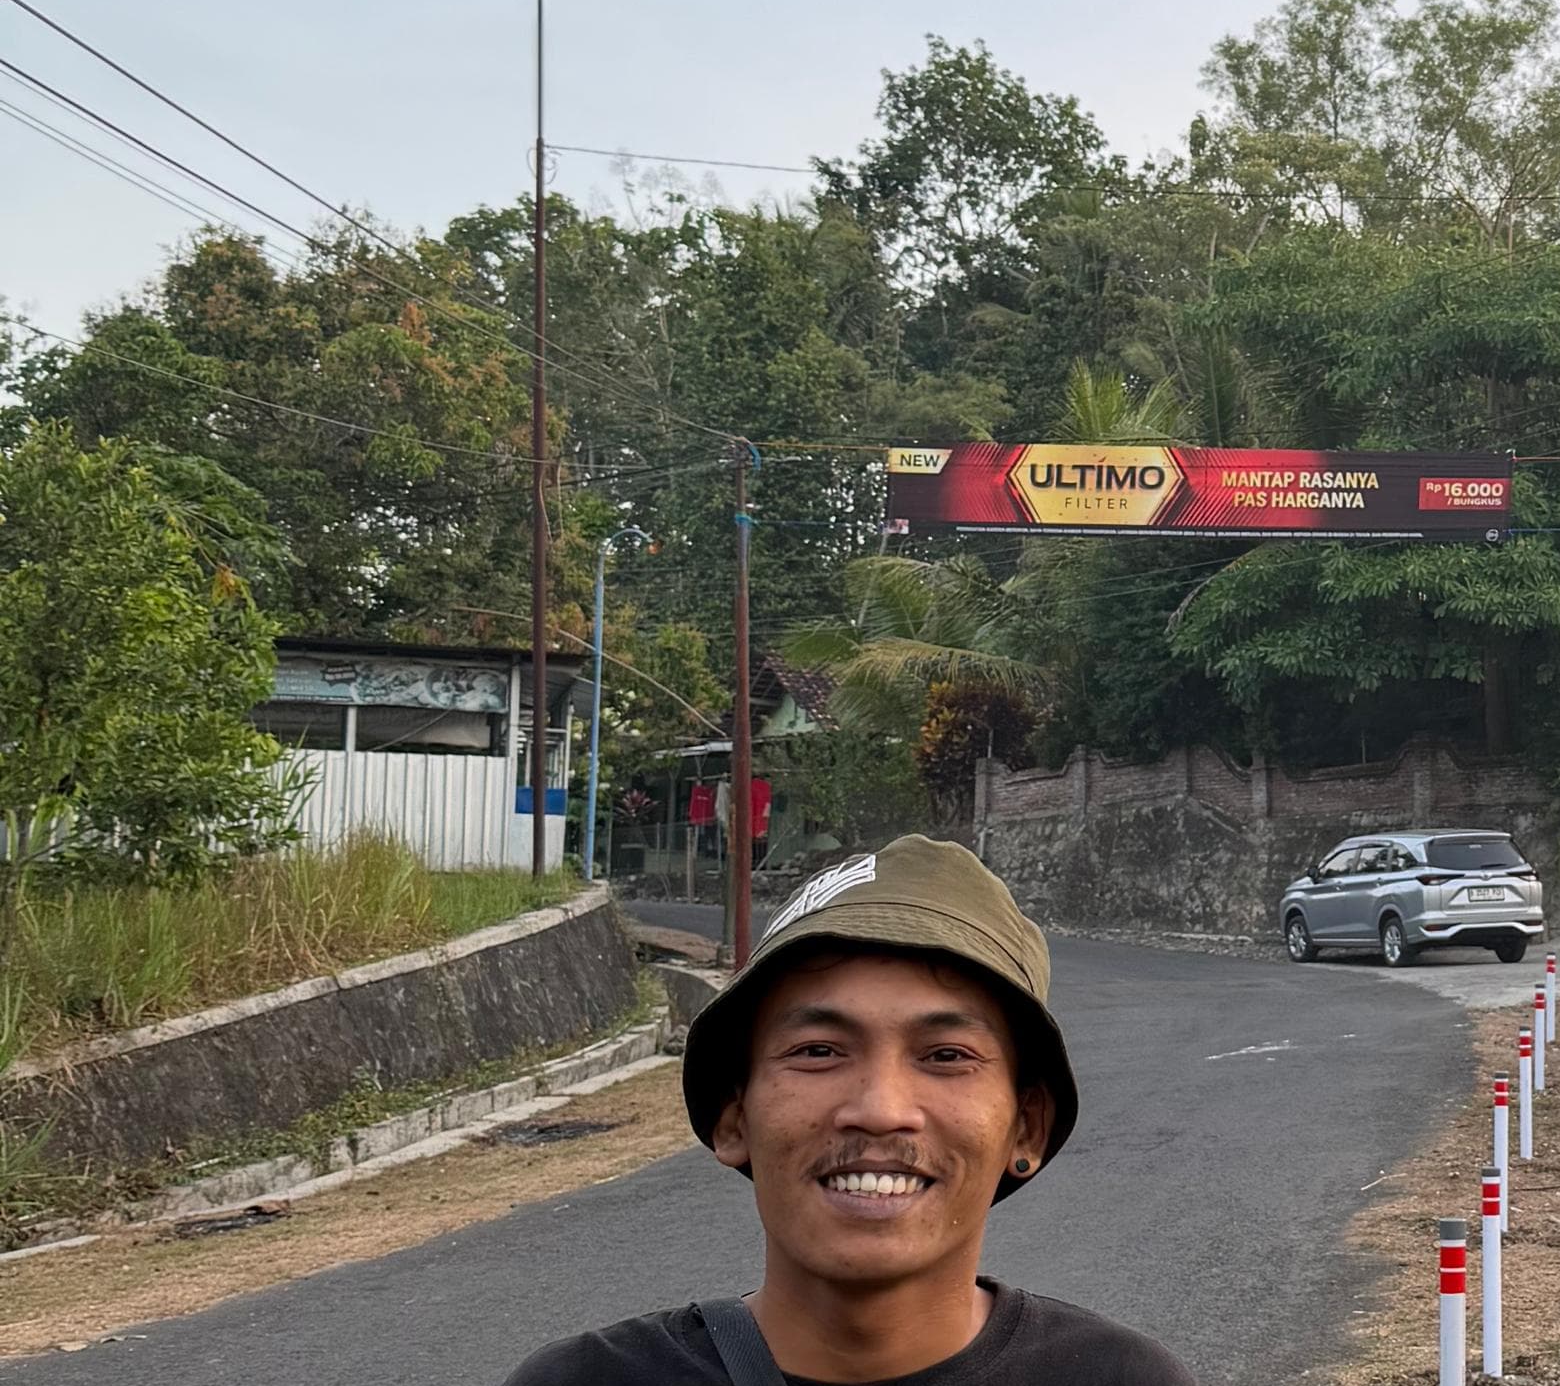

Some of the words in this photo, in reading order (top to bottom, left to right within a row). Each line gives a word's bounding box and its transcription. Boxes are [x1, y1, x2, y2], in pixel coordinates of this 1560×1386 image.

[899, 454, 940, 467] NEW
[1222, 471, 1295, 488] MANTAP
[1299, 471, 1379, 490] RASANYA
[1064, 497, 1128, 510] FILTER
[1233, 491, 1267, 507] PAS
[1271, 491, 1365, 508] HARGANYA
